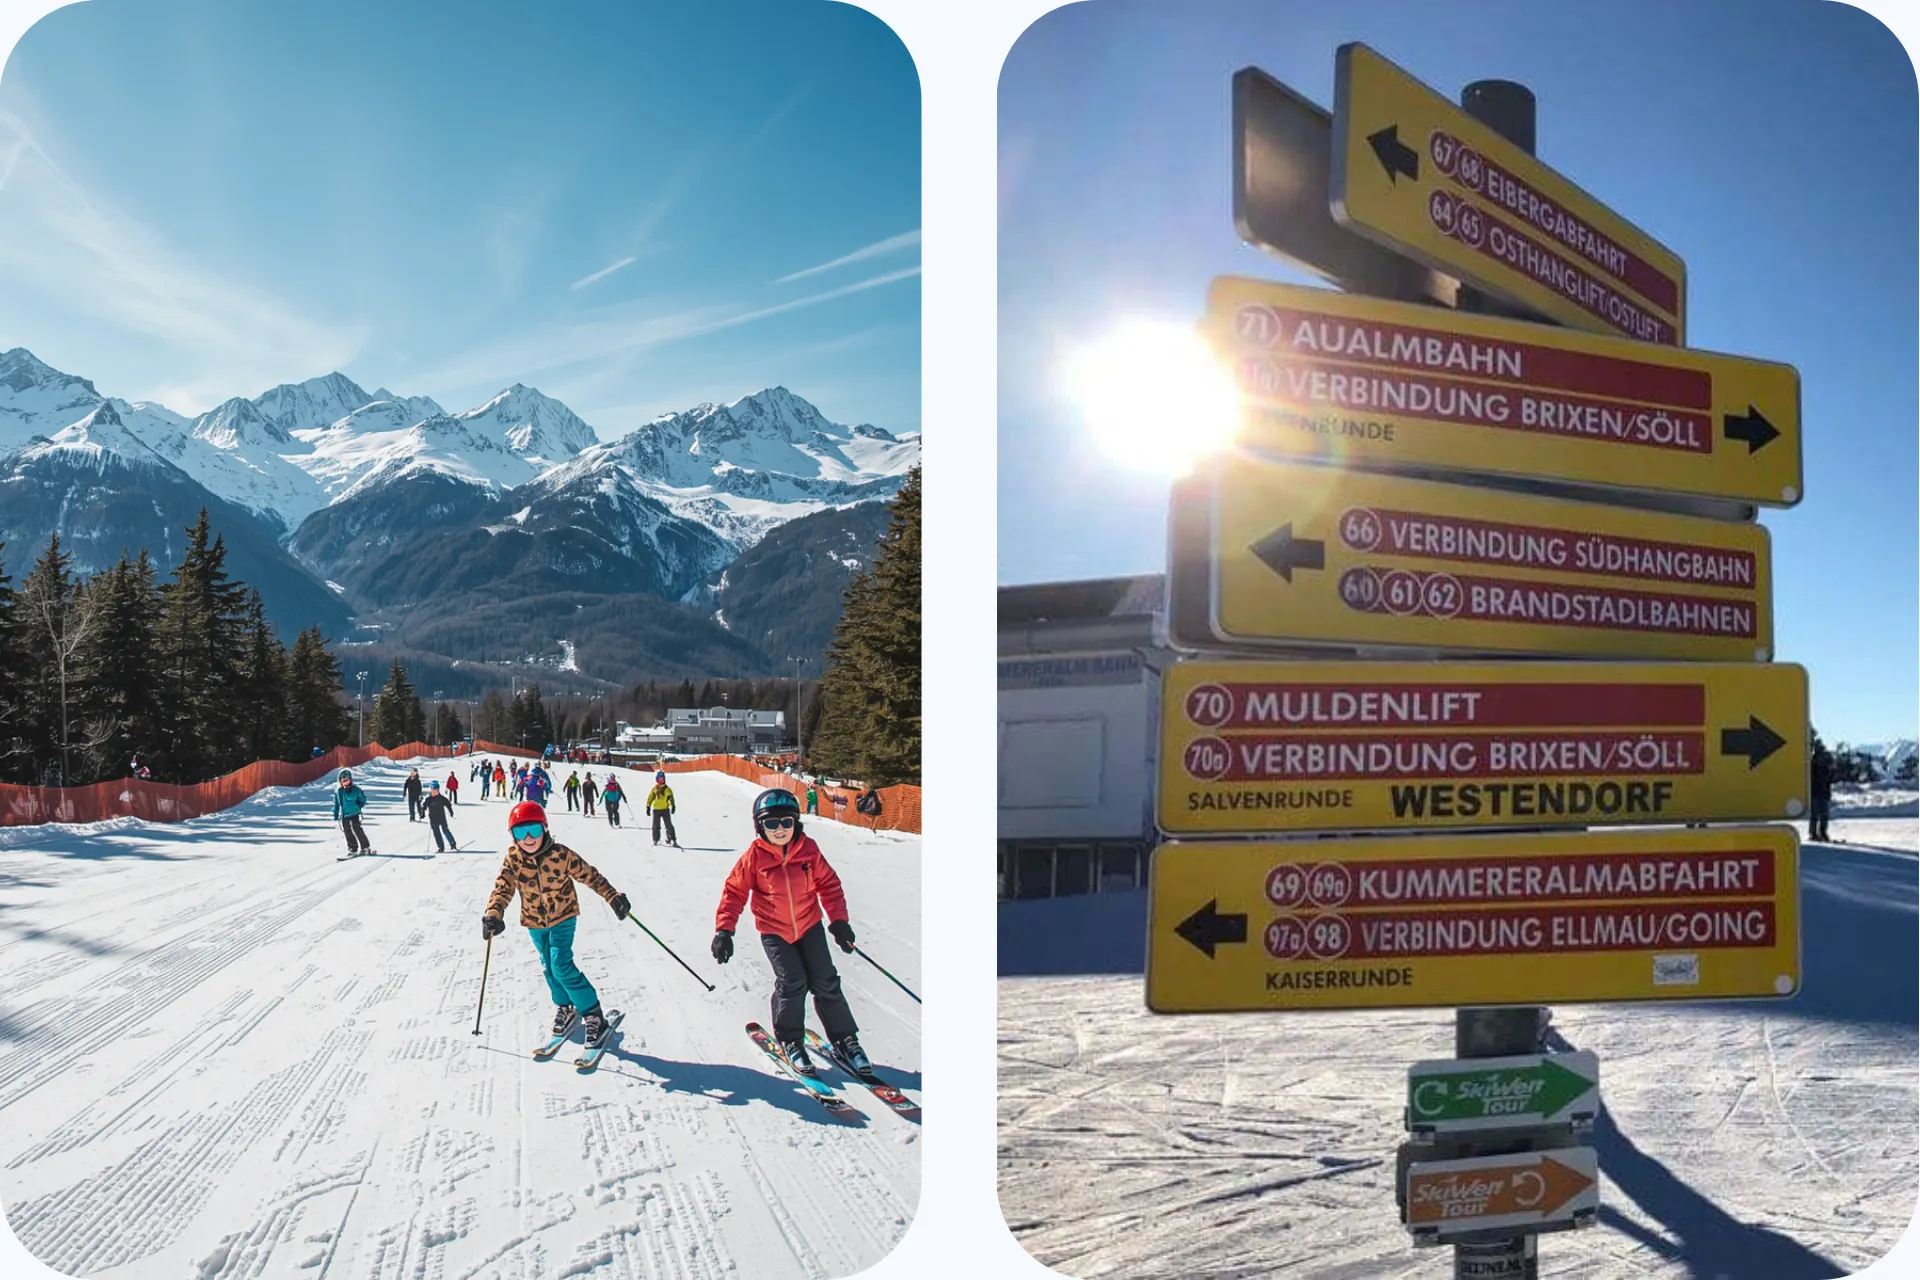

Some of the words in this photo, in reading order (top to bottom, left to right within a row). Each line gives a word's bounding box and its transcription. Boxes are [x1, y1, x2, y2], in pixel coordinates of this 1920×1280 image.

[1433, 141, 1452, 166] 67
[1460, 158, 1480, 184] 68
[1488, 170, 1627, 276] EIBERGABFAHRT
[1432, 200, 1453, 225] 64
[1461, 215, 1481, 240] 65
[1490, 227, 1662, 343] OSTHANGLIFT/OSTLIFT
[1292, 320, 1522, 378] AUALMBAHN
[1286, 369, 1510, 421] VERBINDUNG
[1521, 402, 1700, 448] BRIXEN/SÖLL
[1345, 519, 1374, 542] 66
[1390, 520, 1567, 566] VERBINDUNG
[1575, 537, 1751, 583] SÜDHANGBAHN
[1345, 578, 1374, 602] 60
[1390, 582, 1415, 605] 61
[1427, 585, 1456, 609] 62
[1471, 588, 1751, 632] BRANDSTADLBAHNEN
[1193, 691, 1224, 719] 70
[1244, 692, 1481, 722] MULDENLIFT
[1191, 745, 1224, 771] 70a
[1241, 743, 1477, 774] VERBINDUNG
[1490, 734, 1690, 771] BRIXEN/SÖLL
[1188, 789, 1353, 812] SALVENRUNDE
[1390, 782, 1674, 819] WESTENDORF
[1271, 872, 1299, 897] 69
[1312, 872, 1344, 897] 69a
[1359, 859, 1760, 900] KUMMERERALMABFAHRT
[1269, 925, 1300, 949] 97a
[1314, 922, 1343, 947] 98
[1360, 918, 1543, 952] VERBINDUNG
[1551, 911, 1767, 947] ELLMAU/GOING
[1265, 967, 1414, 990] KAISERRUNDE
[1481, 1098, 1529, 1114] Tour
[1440, 1201, 1488, 1217] Tour
